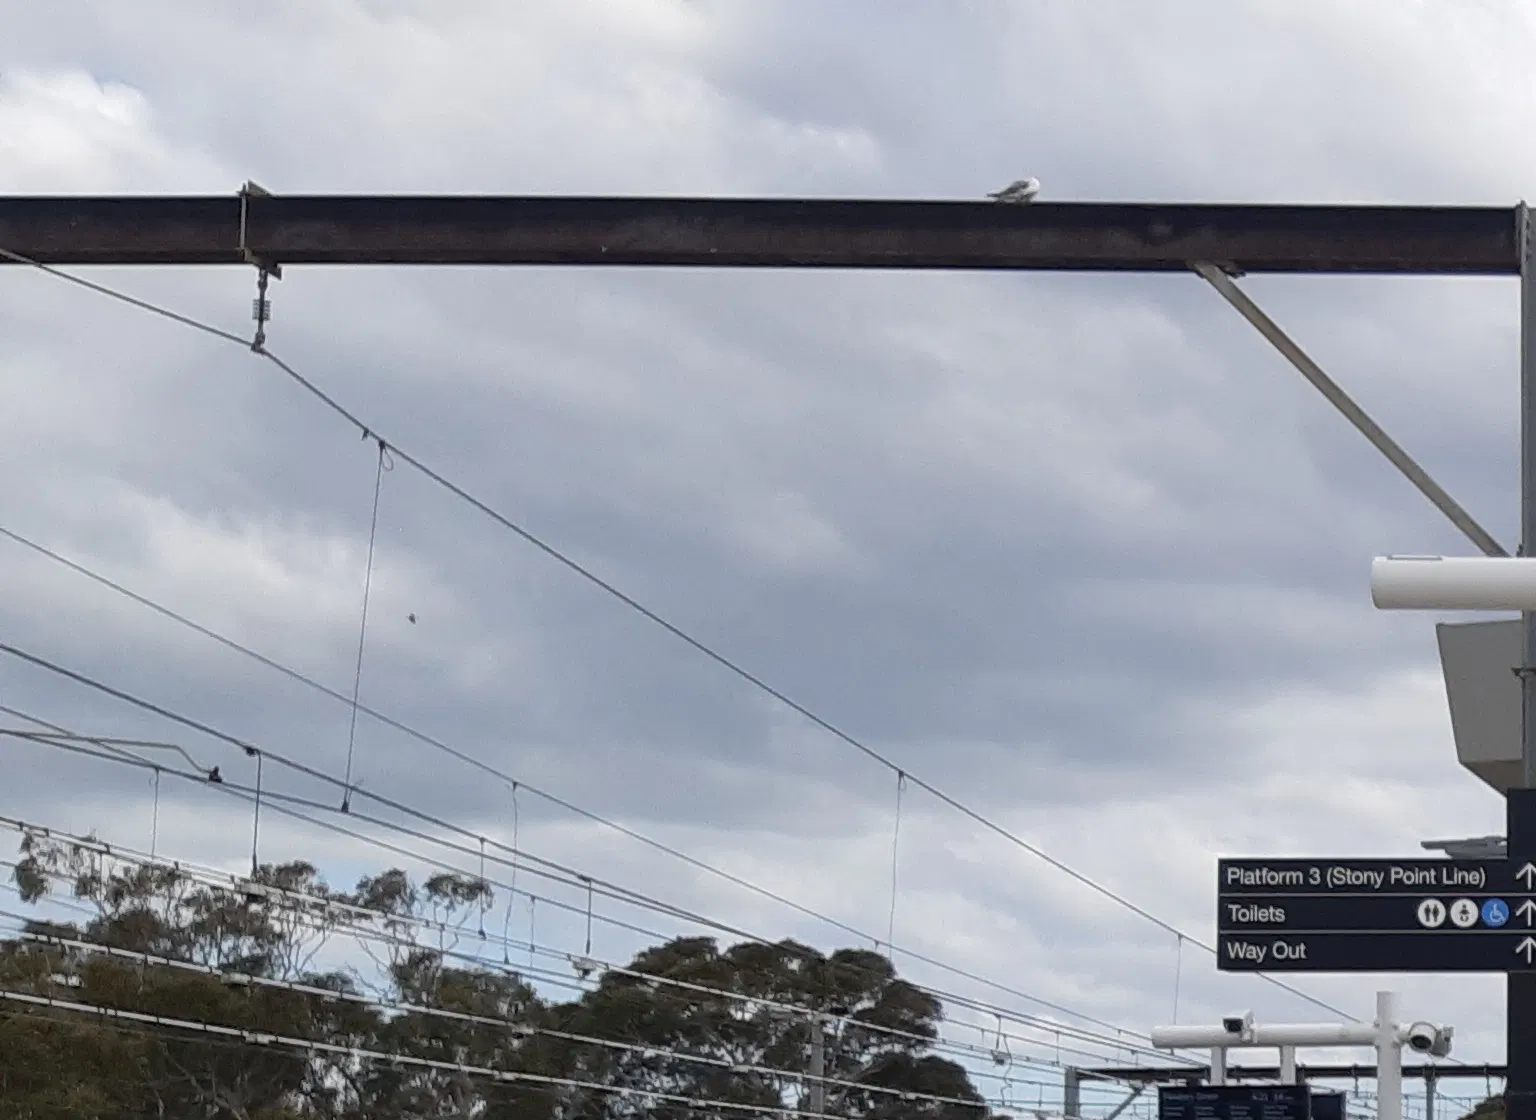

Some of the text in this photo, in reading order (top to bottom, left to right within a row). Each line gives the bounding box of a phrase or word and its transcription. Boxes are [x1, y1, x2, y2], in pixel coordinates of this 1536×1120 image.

[1227, 866, 1486, 889] Platform 3 (Stony Point Line)
[1227, 904, 1286, 922] Toilets
[1227, 941, 1307, 963] Way Out
